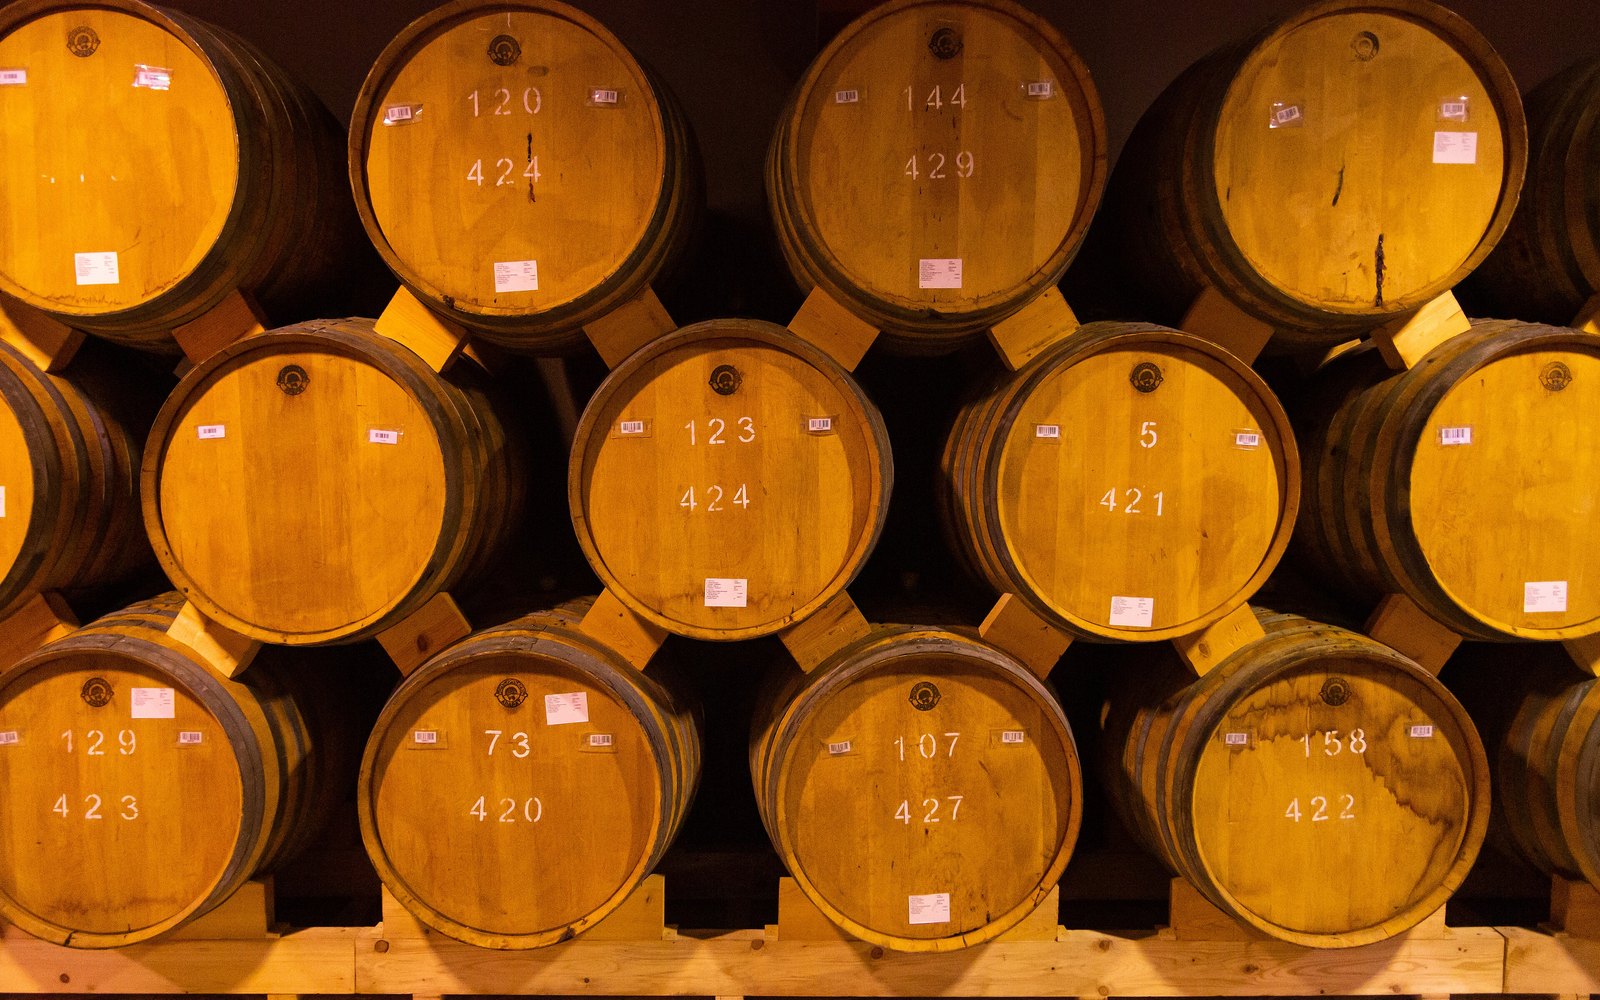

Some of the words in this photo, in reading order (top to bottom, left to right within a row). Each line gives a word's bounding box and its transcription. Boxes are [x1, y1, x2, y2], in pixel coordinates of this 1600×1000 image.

[467, 86, 543, 116] 120
[901, 83, 968, 111] 144
[466, 155, 542, 187] 424
[905, 151, 974, 180] 429
[684, 416, 756, 446] 123
[1139, 421, 1159, 449] 5
[679, 483, 751, 512] 424
[1099, 487, 1164, 517] 421
[61, 729, 137, 756] 129
[484, 729, 532, 759] 73
[893, 731, 961, 762] 107
[1299, 727, 1368, 758] 158
[52, 793, 139, 821] 423
[469, 795, 543, 823] 420
[894, 795, 964, 825] 427
[1285, 793, 1355, 823] 422
